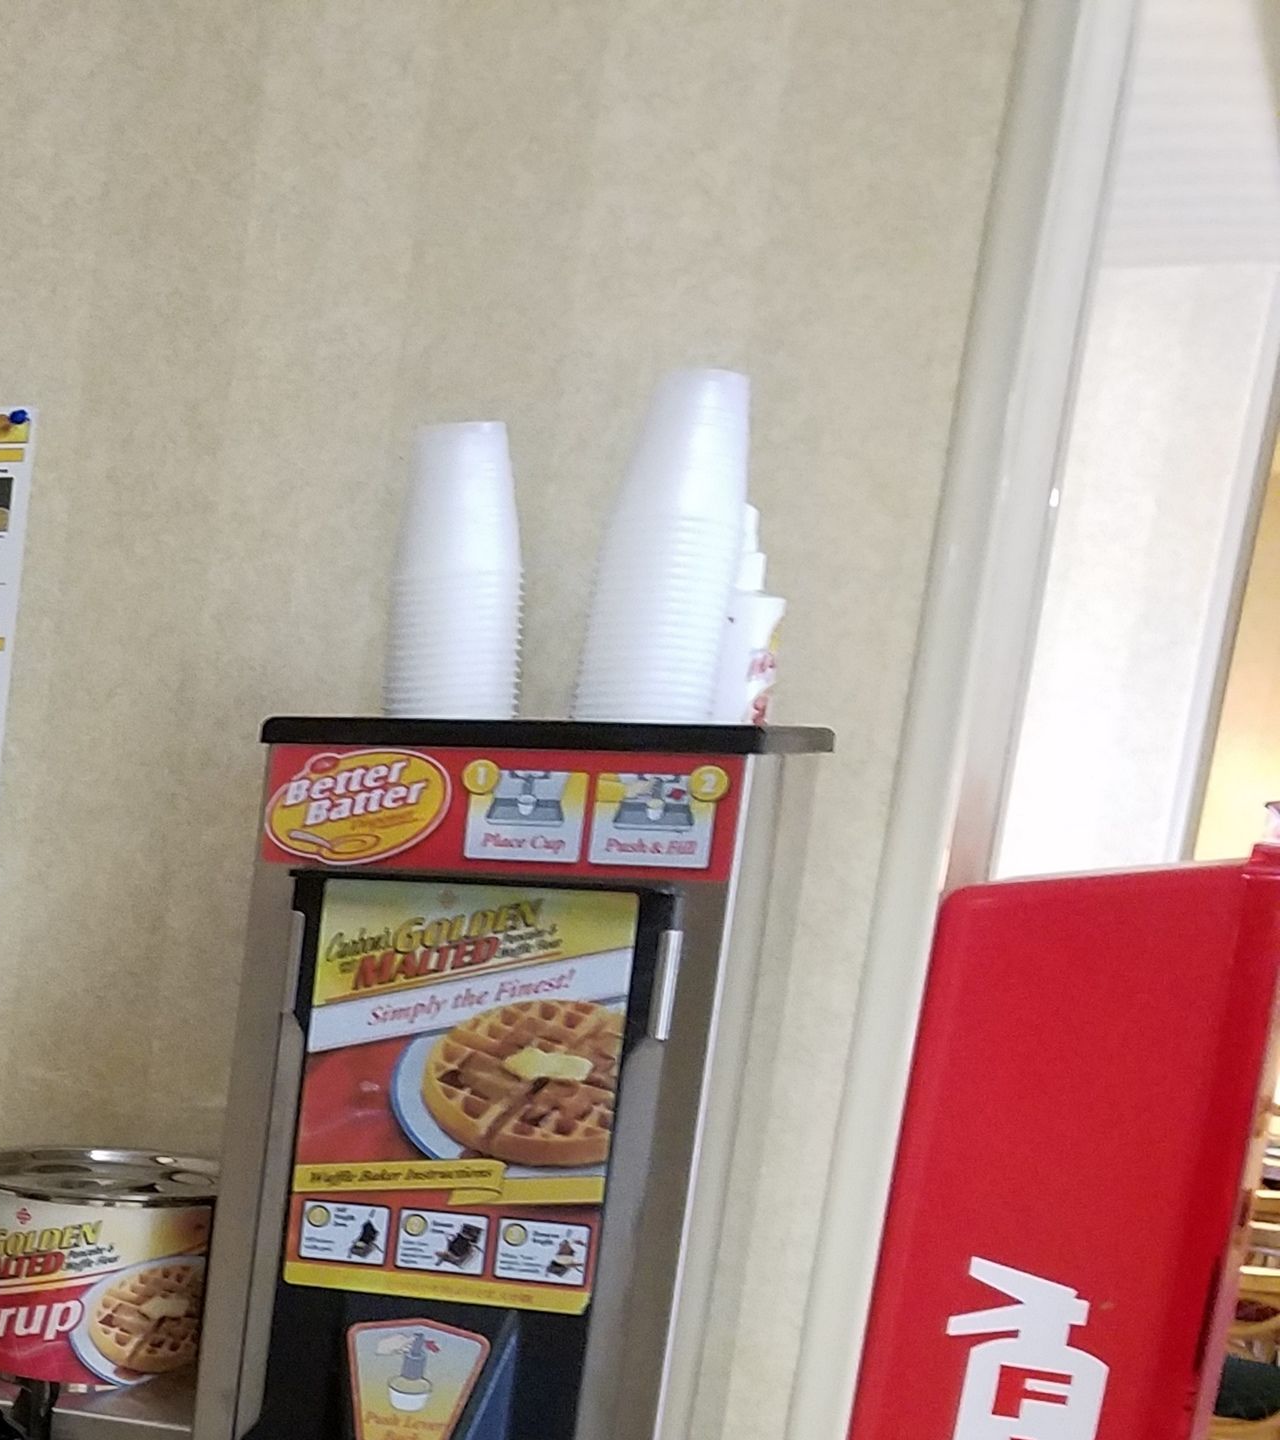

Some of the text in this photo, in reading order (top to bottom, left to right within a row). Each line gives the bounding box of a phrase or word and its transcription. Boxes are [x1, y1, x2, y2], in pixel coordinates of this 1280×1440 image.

[282, 759, 410, 808] Better
[303, 779, 428, 827] Batter
[700, 773, 719, 792] 2
[481, 832, 566, 854] Place Cup
[605, 838, 645, 853] Push
[392, 898, 545, 954] GOLDEN
[352, 936, 500, 990] MALTED
[367, 968, 577, 1025] Simply the Finest!
[309, 1166, 494, 1186] Waffle Baker Instructions
